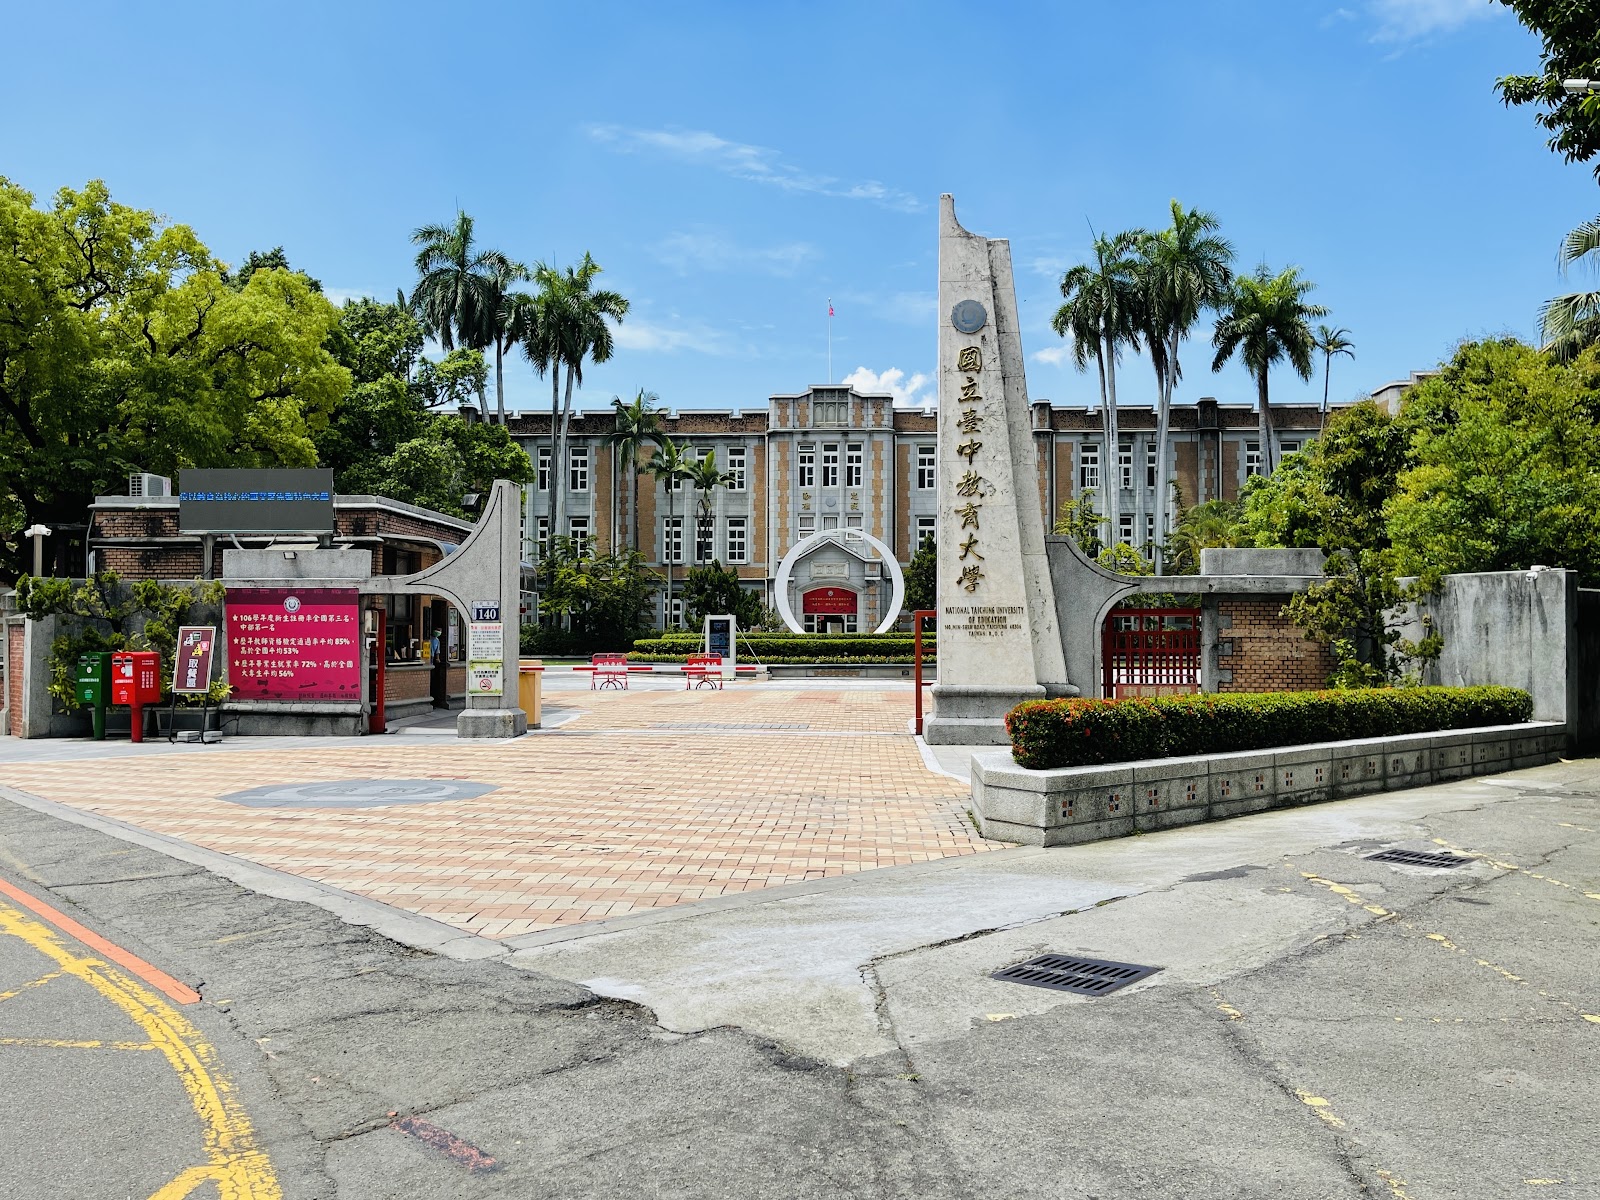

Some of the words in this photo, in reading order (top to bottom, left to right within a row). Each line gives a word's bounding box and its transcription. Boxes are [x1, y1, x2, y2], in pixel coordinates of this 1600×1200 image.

[954, 346, 985, 593] 國立臺中教育大學
[478, 608, 497, 620] 140
[945, 606, 970, 615] NATIONAL
[971, 606, 995, 615] TAICHUNG
[996, 606, 1025, 615] UNIVERSITY
[968, 616, 975, 624] OF
[977, 616, 1007, 624] EDUCATION
[240, 623, 276, 632] 中部第一名
